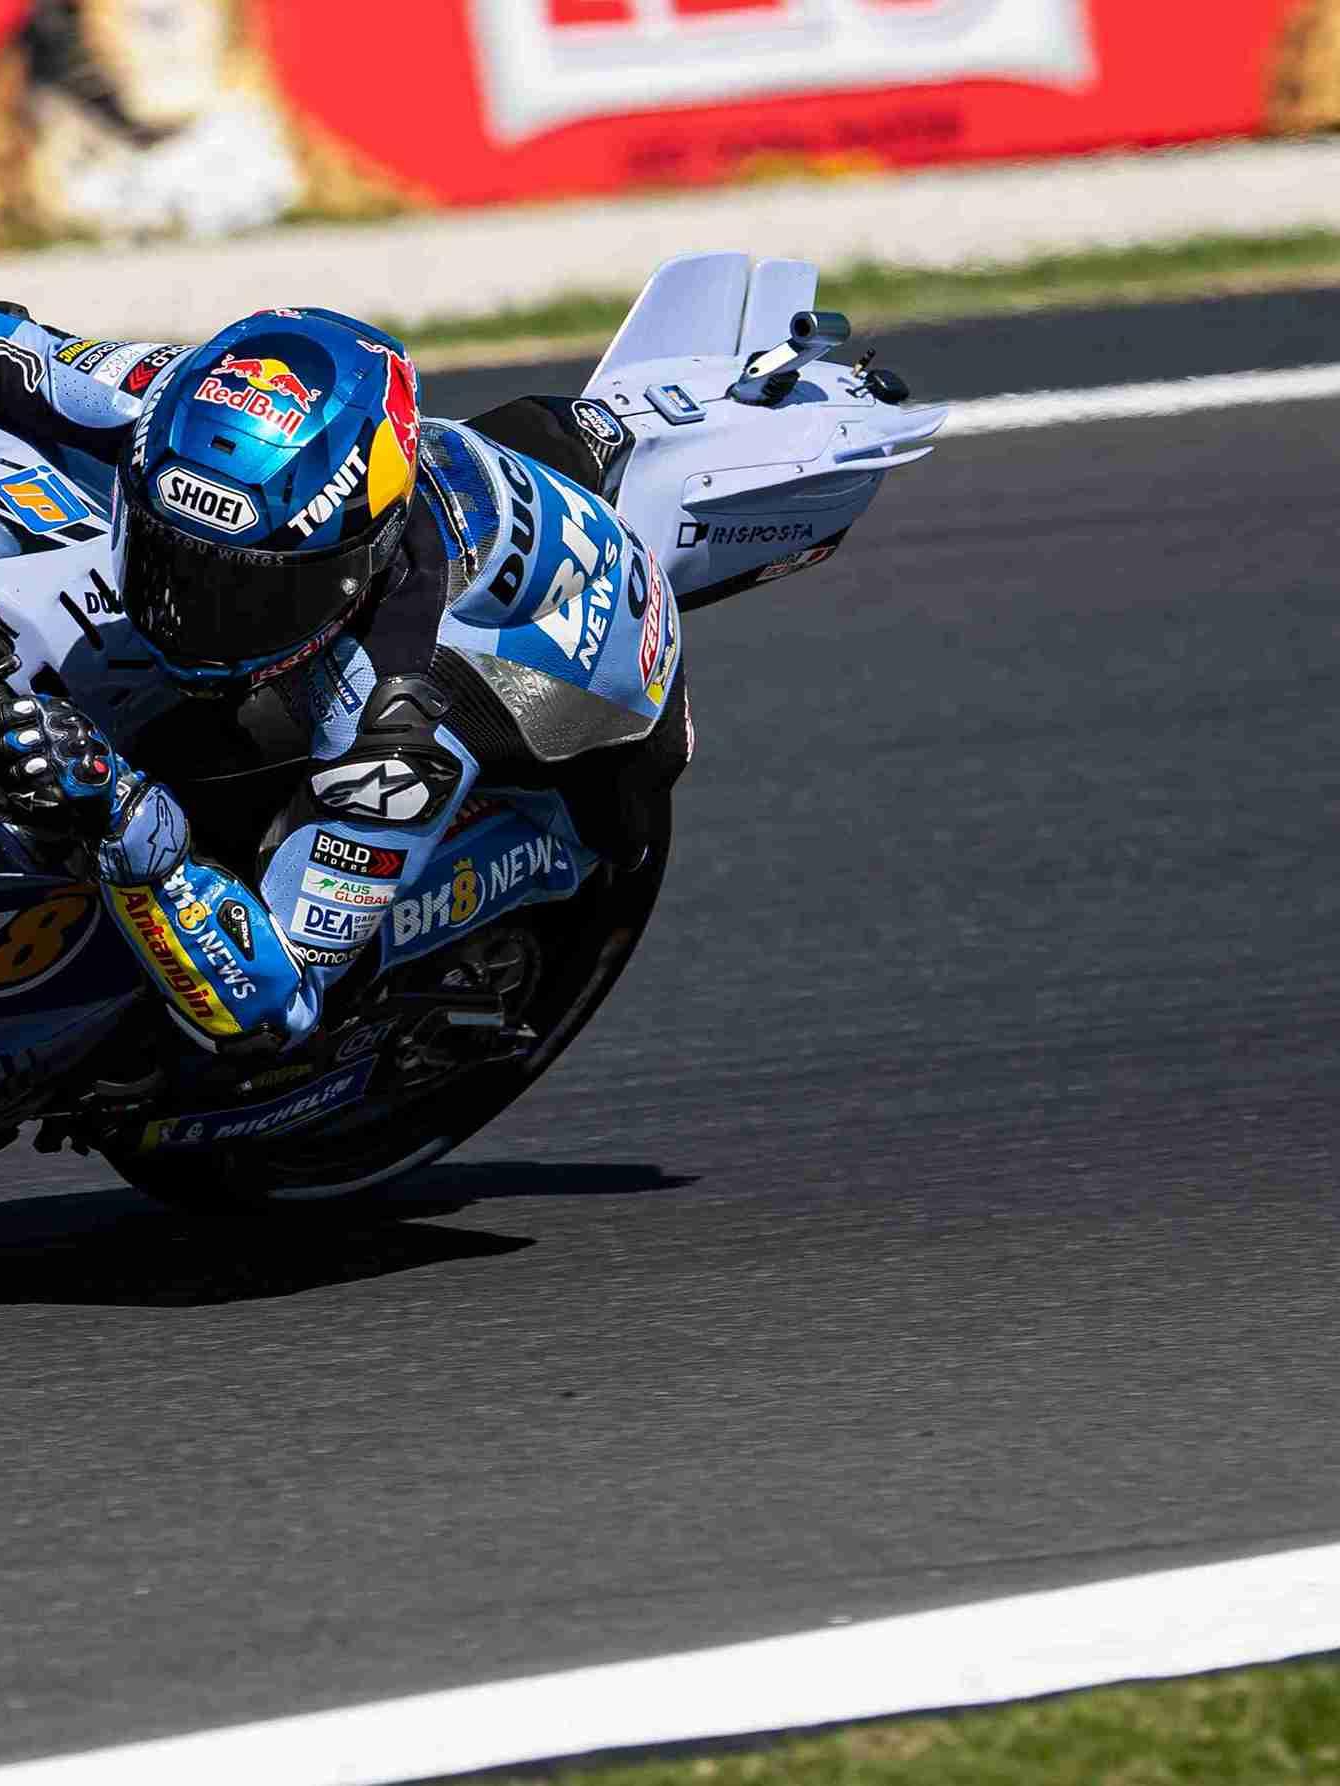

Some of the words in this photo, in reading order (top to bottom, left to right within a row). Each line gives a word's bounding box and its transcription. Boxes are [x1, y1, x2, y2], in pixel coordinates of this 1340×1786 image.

[194, 377, 248, 411] Red
[248, 391, 304, 439] Bull
[167, 476, 242, 525] SHOEI
[712, 524, 813, 545] RISPOSTA
[314, 852, 368, 873] RIDERS
[316, 835, 371, 865] BOLD
[340, 881, 373, 895] AUS
[304, 904, 354, 940] DEA
[392, 868, 476, 946] BK8
[197, 929, 256, 1000] NEWS
